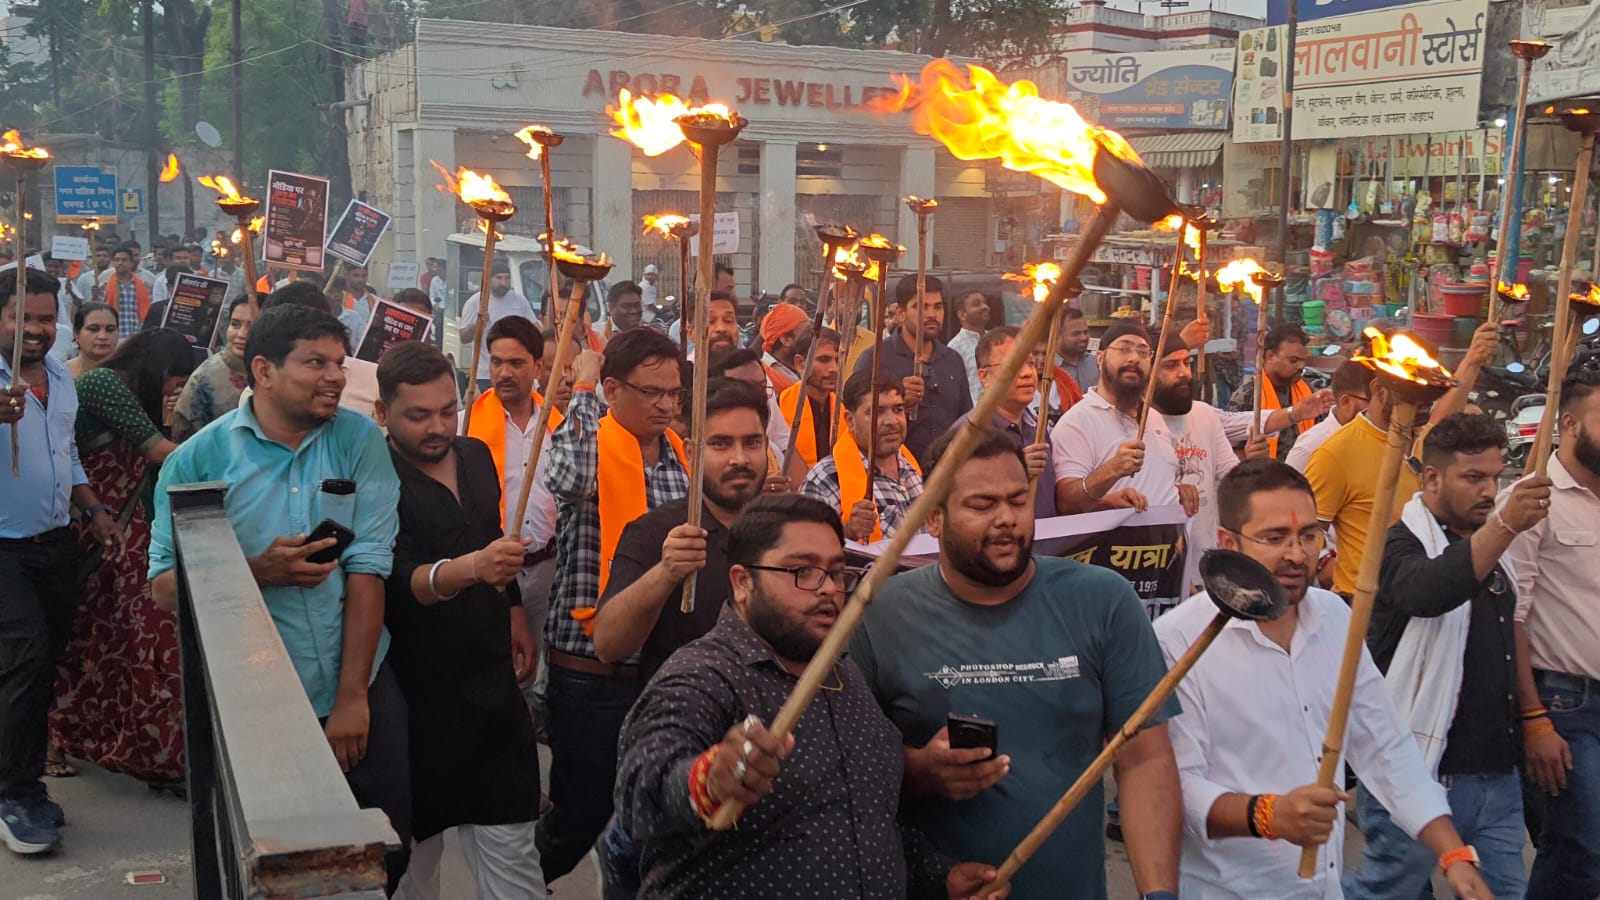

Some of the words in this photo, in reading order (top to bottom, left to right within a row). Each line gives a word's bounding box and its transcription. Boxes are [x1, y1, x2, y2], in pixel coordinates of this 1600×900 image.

[1422, 12, 1484, 66] स्टोर्स
[1072, 56, 1142, 84] ज्योति
[1110, 544, 1171, 570] यात्रा
[960, 663, 1014, 672] PHOTOSHOP
[961, 677, 972, 685] IN
[974, 676, 1010, 684] LONDON
